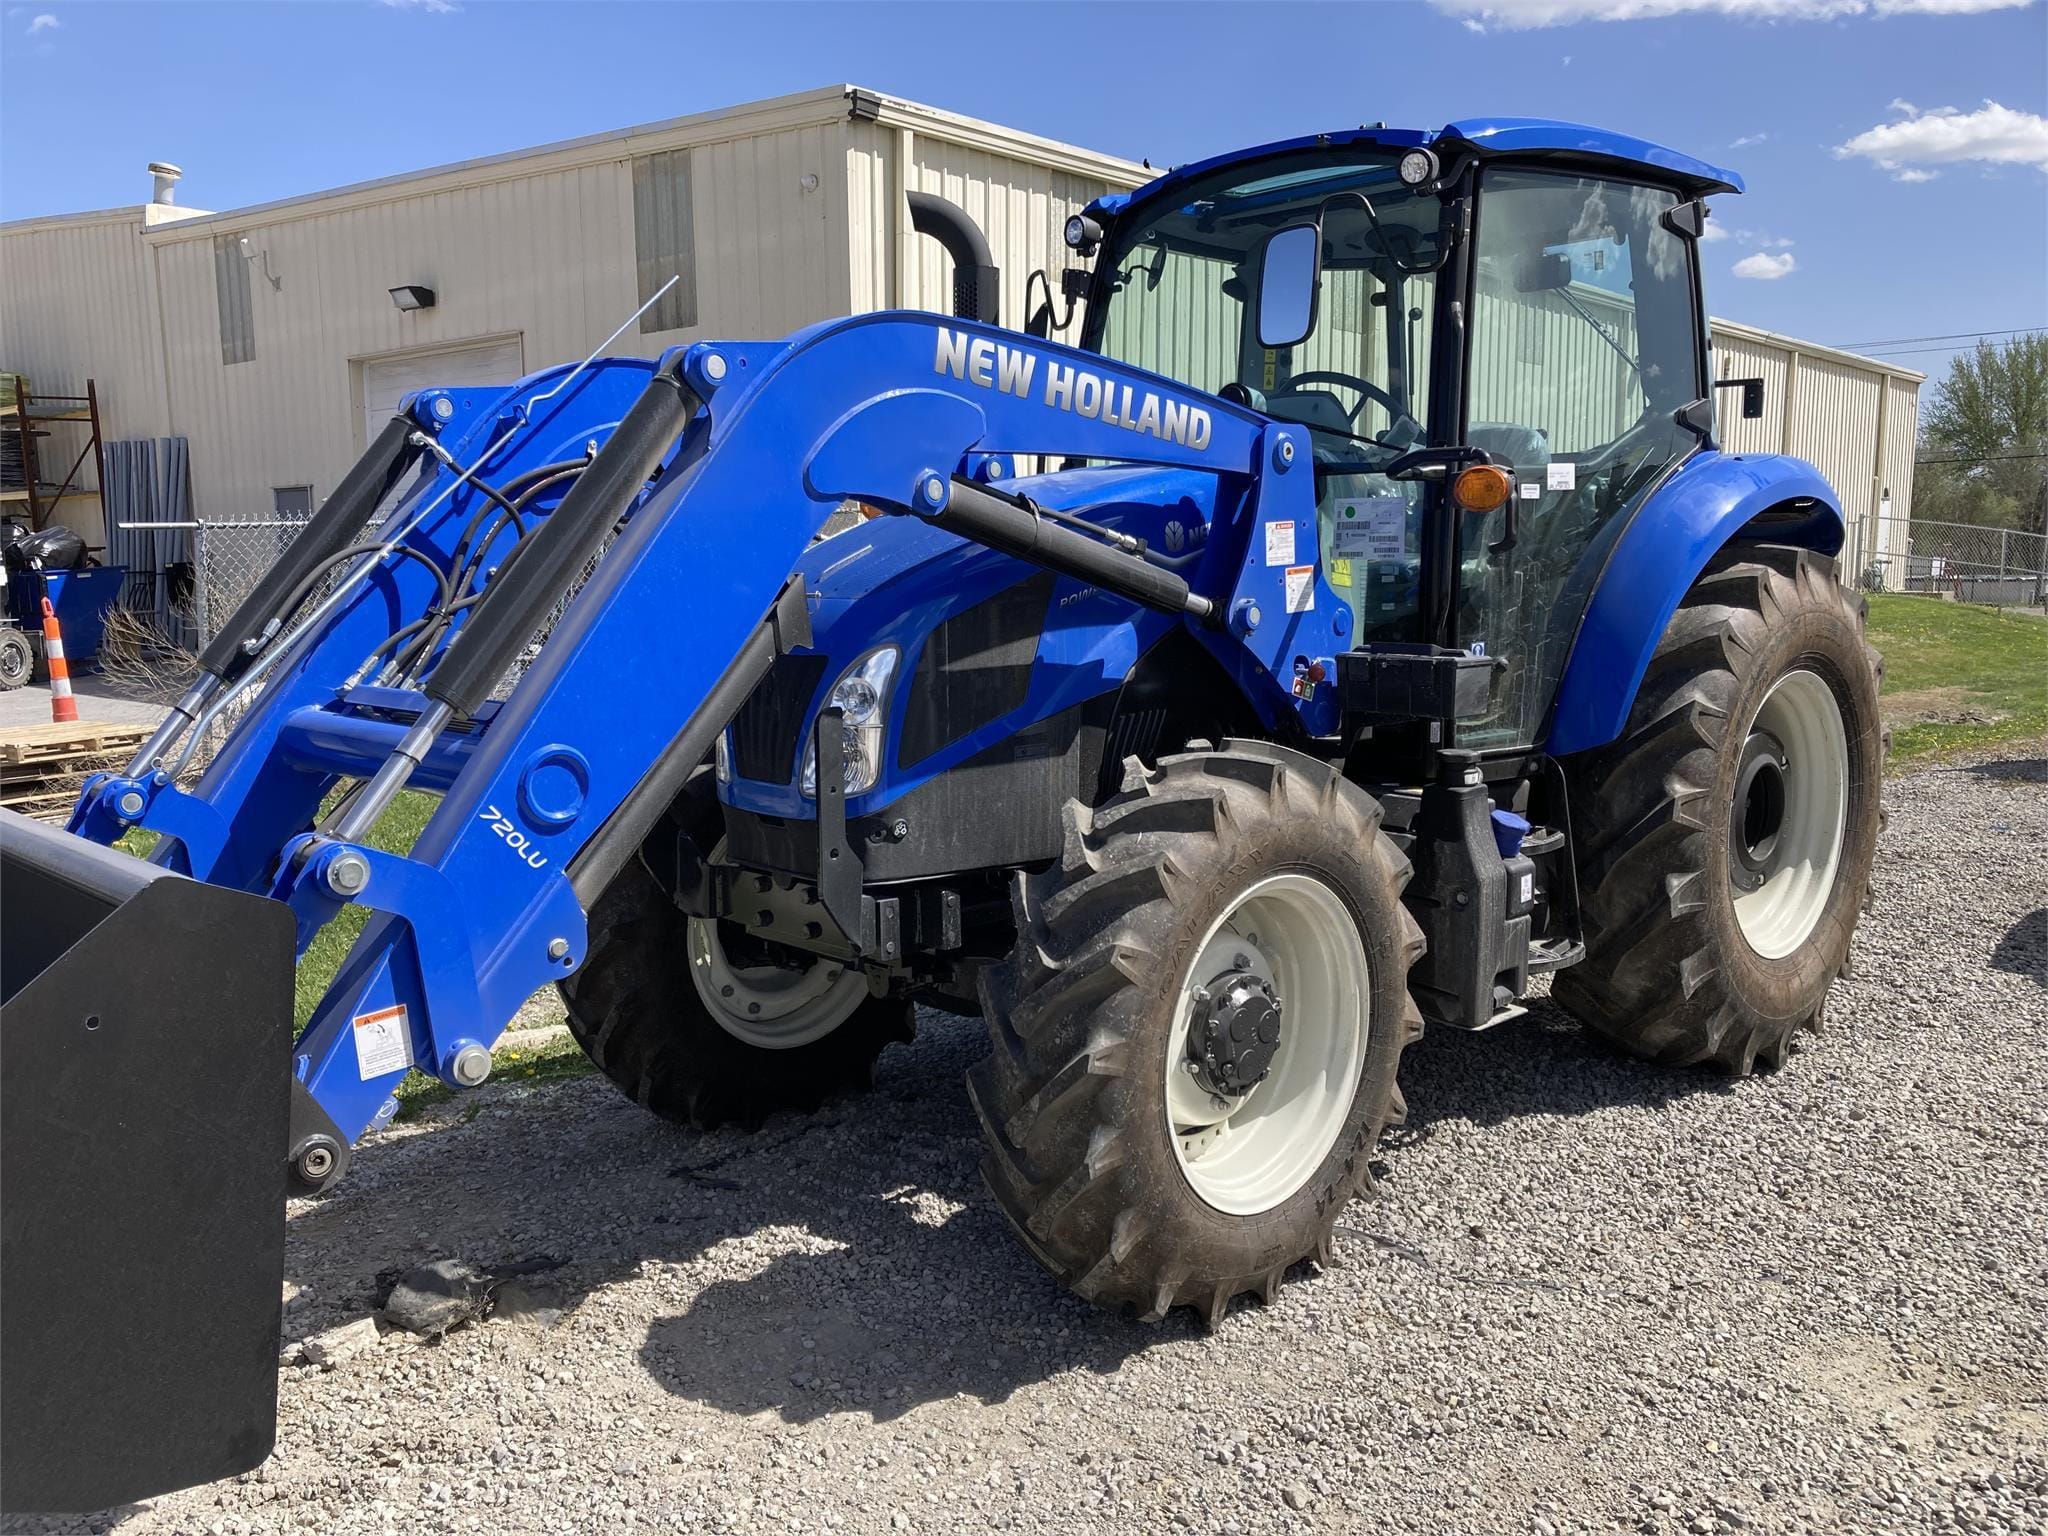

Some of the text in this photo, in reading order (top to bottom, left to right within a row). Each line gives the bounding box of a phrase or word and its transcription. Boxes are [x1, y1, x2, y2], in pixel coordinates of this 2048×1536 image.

[934, 326, 1212, 451] NEW HOLLAND
[1060, 585, 1097, 608] POW
[479, 804, 548, 868] 720LU
